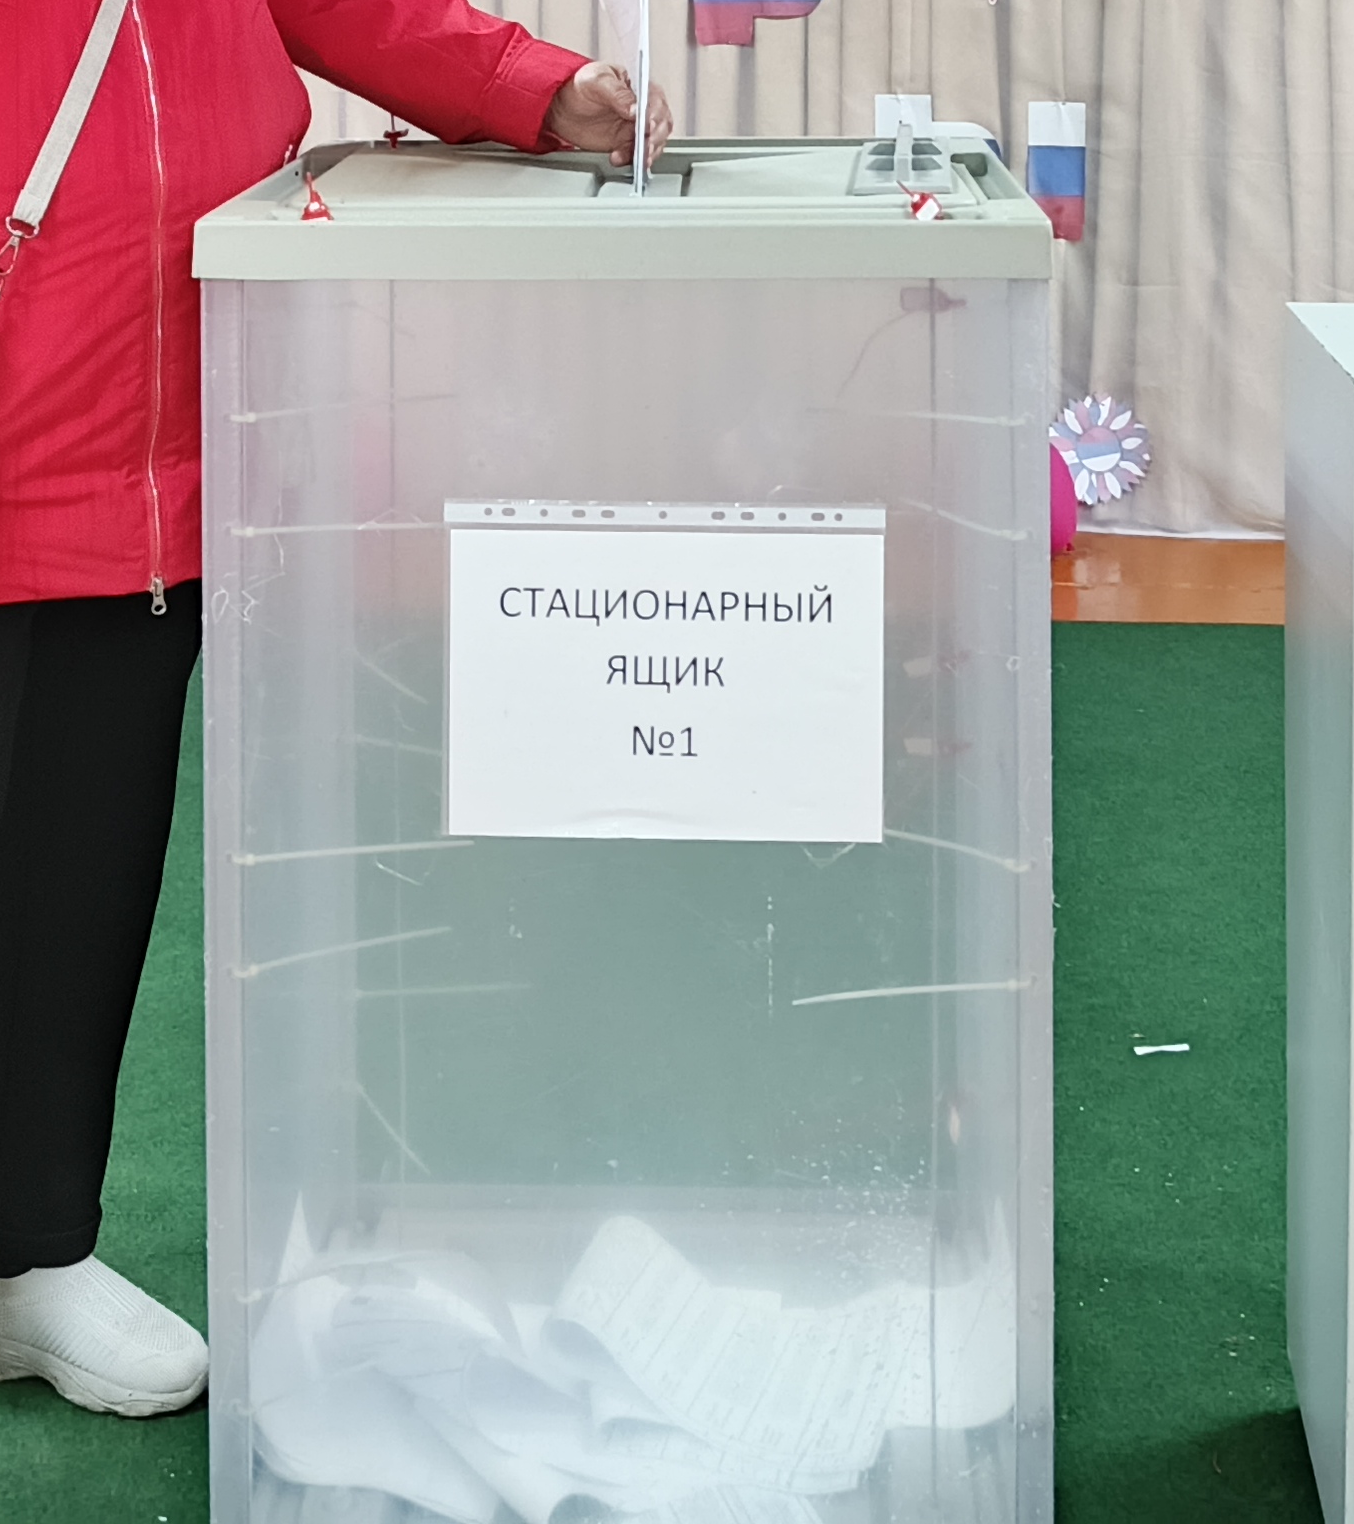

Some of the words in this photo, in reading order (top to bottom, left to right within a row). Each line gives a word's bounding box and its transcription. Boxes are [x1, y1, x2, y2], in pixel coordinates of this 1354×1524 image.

[498, 584, 834, 627] СТАЦИОНАРНЫЙ
[606, 654, 726, 694] ЯЩИК
[631, 725, 698, 758] №1
